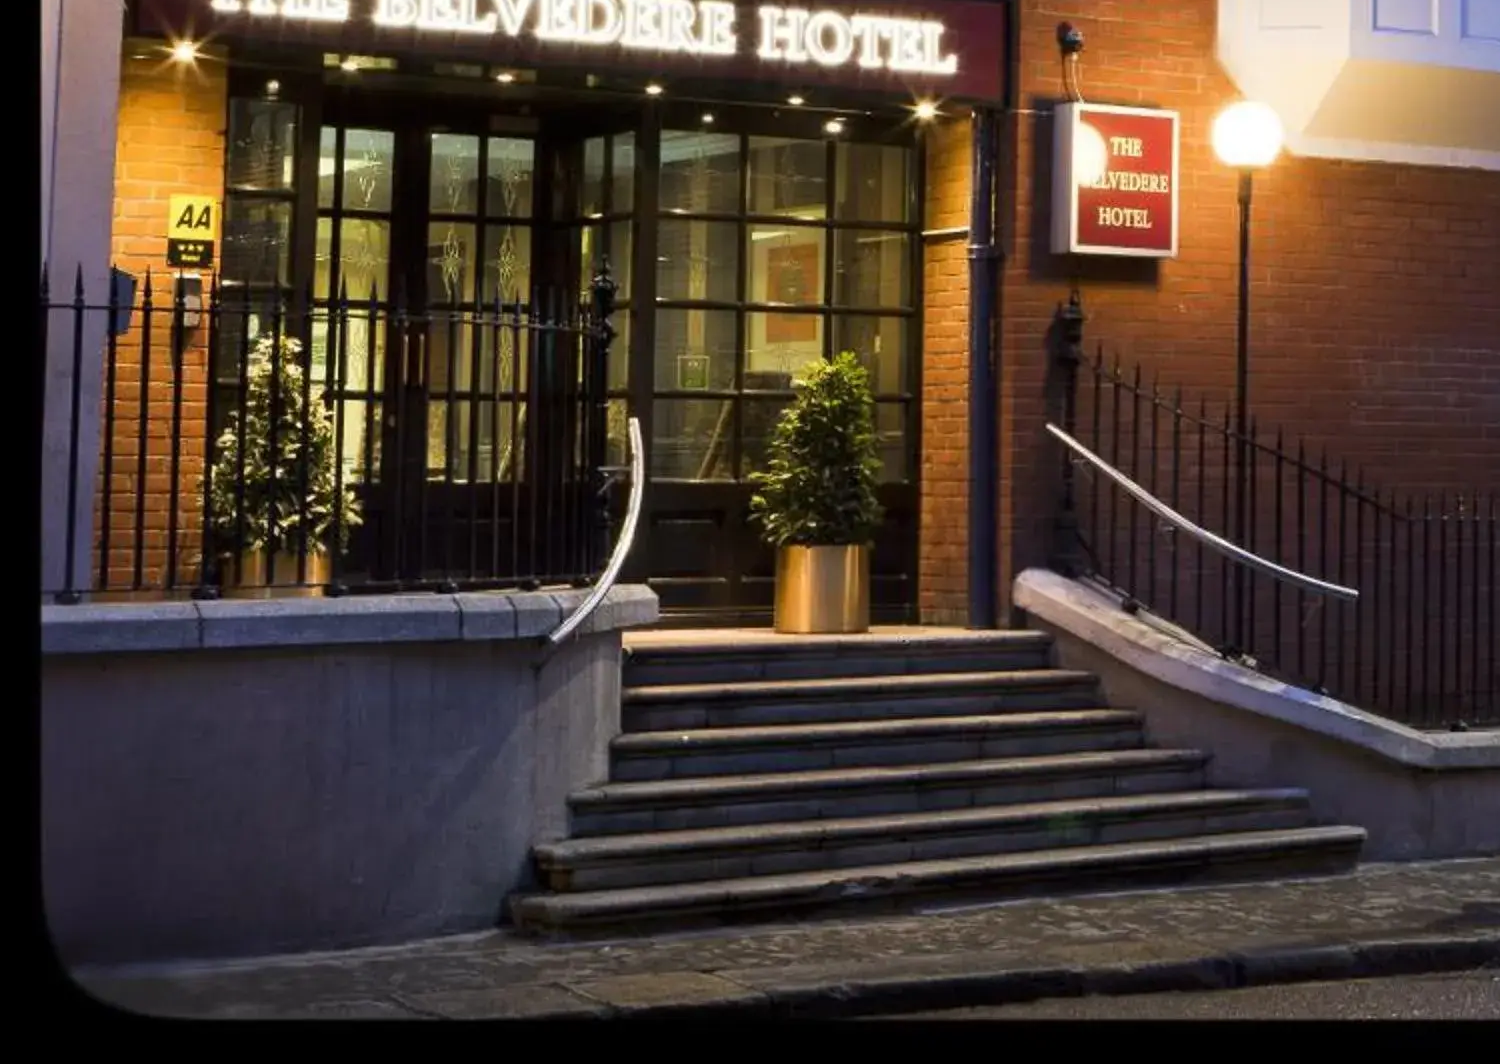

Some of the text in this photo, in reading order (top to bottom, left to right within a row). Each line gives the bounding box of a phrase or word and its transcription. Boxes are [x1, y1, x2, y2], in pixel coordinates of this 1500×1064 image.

[757, 5, 957, 74] HOTEL
[1109, 136, 1143, 157] THE
[1089, 170, 1169, 193] LVEDERE
[176, 203, 211, 231] AA
[1097, 206, 1152, 229] HOTEL
